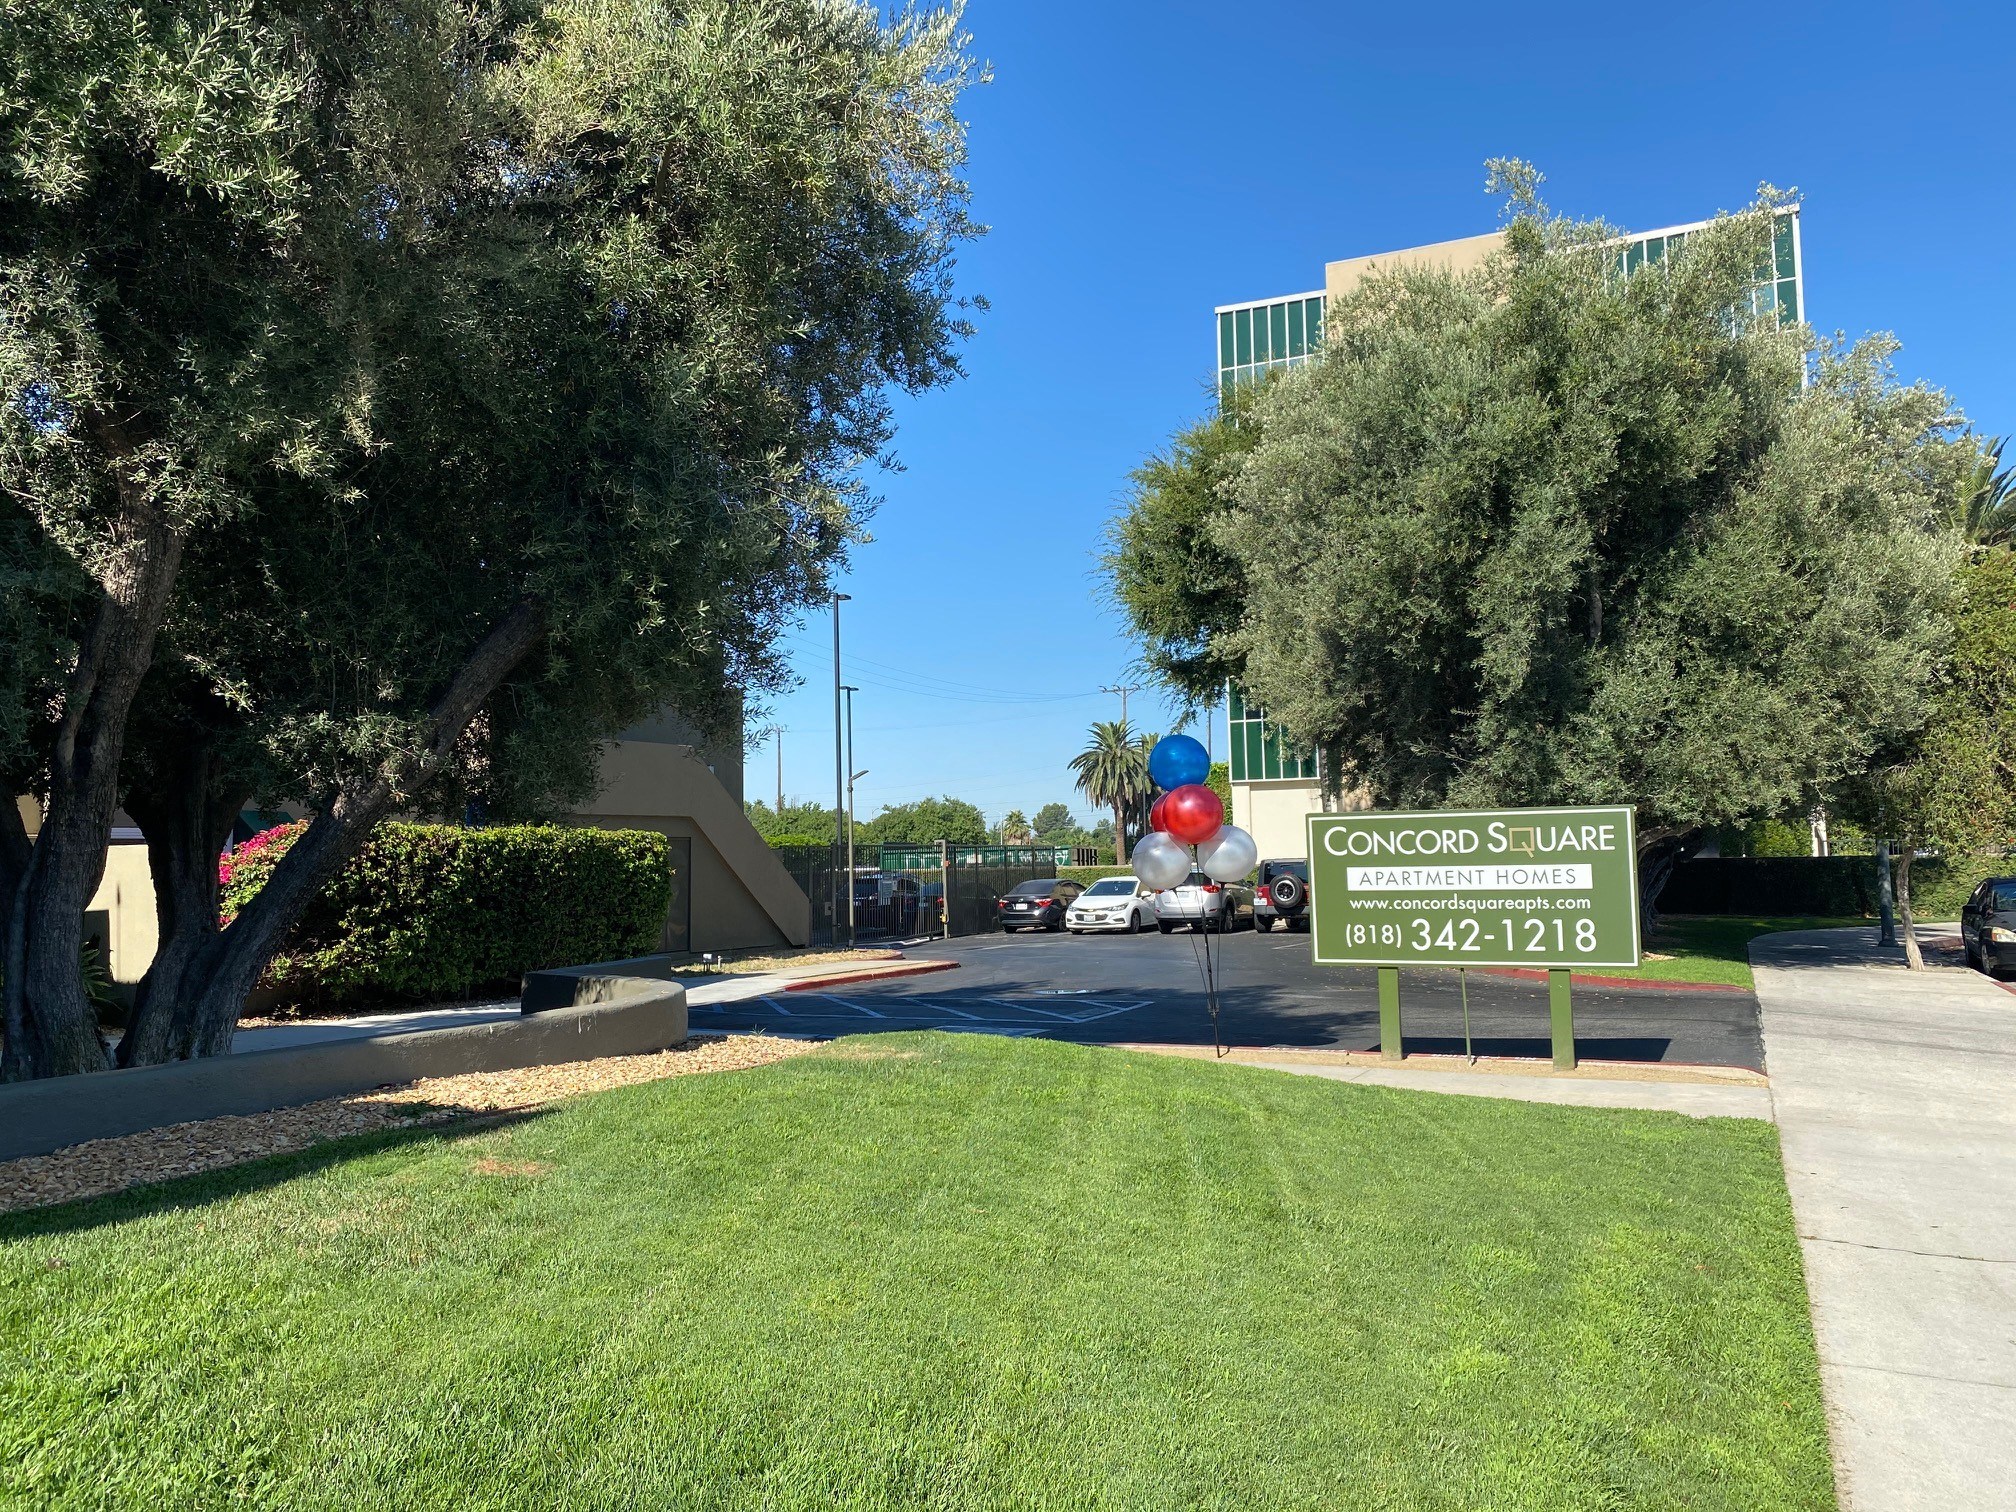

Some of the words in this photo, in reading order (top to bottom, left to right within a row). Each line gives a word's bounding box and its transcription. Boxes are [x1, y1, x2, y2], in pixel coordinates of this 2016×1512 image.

[1324, 826, 1479, 856] CONCORD
[1487, 822, 1616, 858] SQUARE
[1360, 870, 1484, 886] APARTMENT
[1496, 868, 1577, 885] HOMES
[1349, 893, 1591, 914] www.concordsquareapts.com
[1346, 923, 1402, 948] (818)
[1411, 918, 1597, 952] 342-1218
